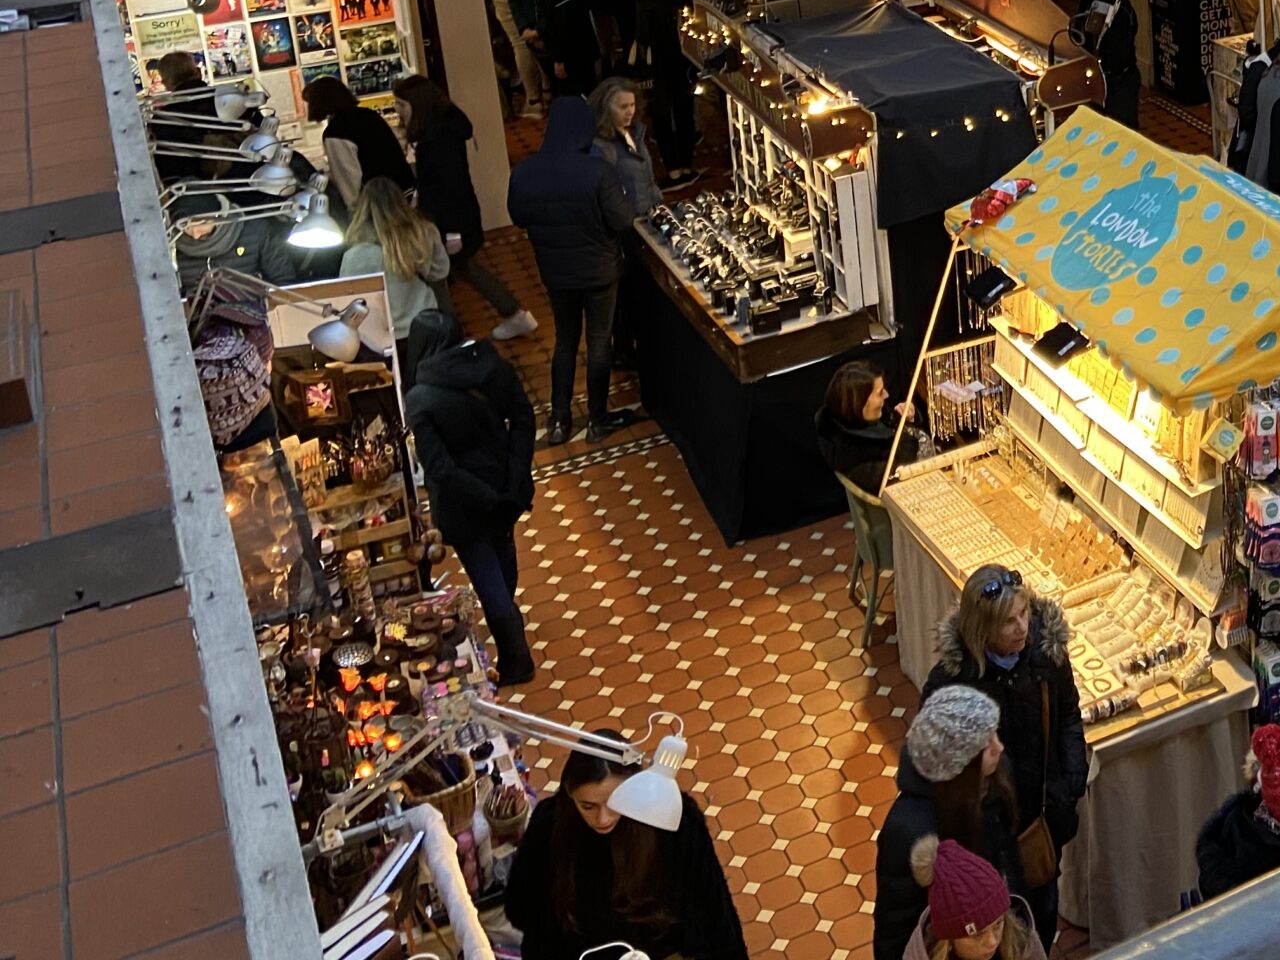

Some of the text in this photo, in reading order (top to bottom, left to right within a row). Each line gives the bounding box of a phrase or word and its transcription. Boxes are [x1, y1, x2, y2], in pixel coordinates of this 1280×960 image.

[152, 16, 184, 30] Sorry!
[1200, 8, 1222, 21] GET
[1200, 19, 1229, 33] MON
[1131, 192, 1162, 218] the
[1090, 202, 1159, 249] LONDON
[1062, 229, 1138, 280] STORIES
